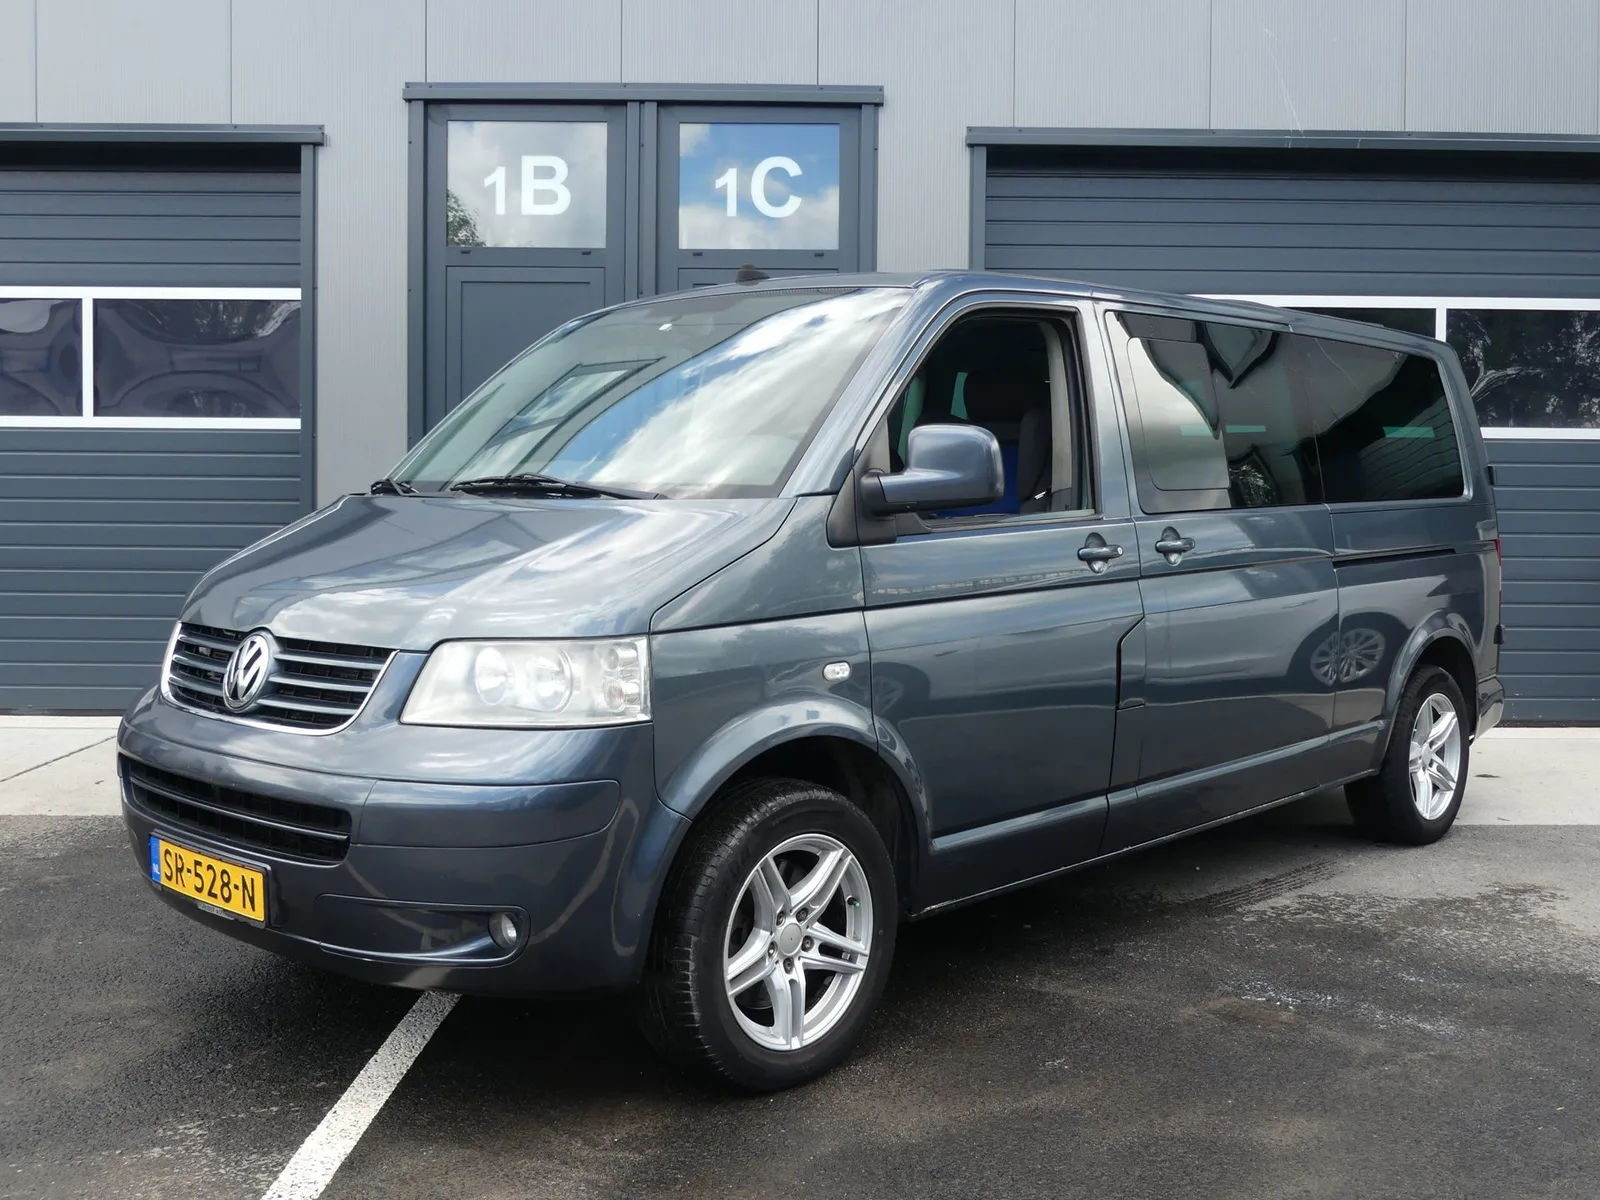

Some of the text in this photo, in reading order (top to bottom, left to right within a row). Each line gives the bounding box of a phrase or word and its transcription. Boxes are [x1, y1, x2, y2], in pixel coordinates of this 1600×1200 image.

[483, 155, 572, 216] 1B
[715, 155, 803, 218] 1C
[164, 848, 256, 912] SR-528-N
